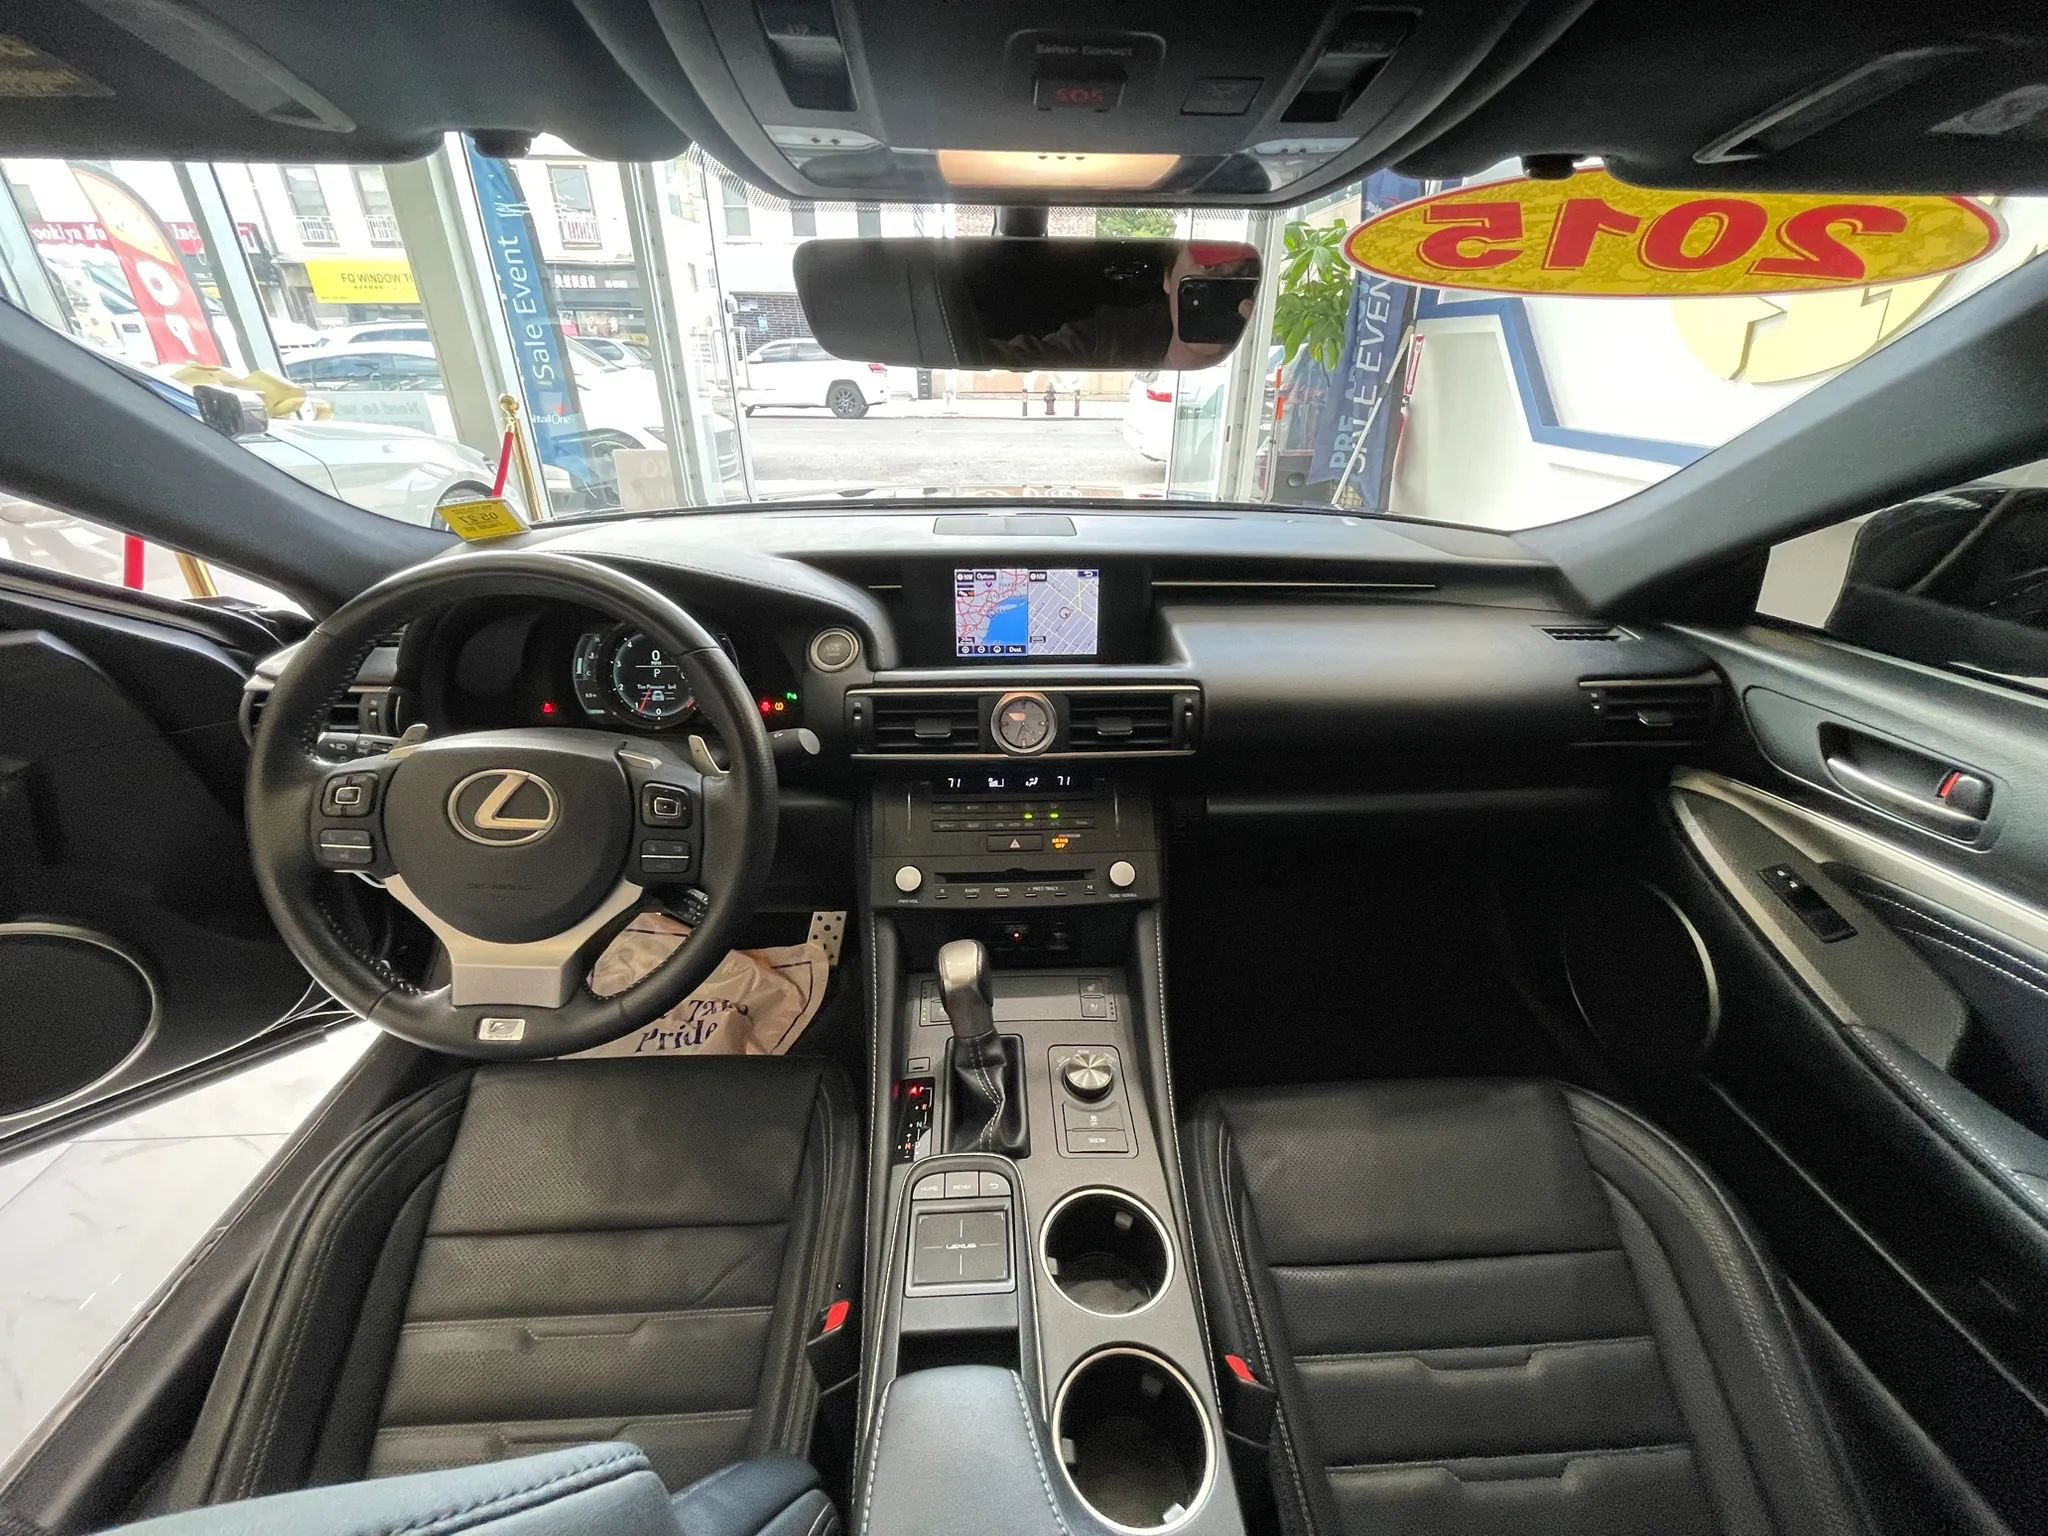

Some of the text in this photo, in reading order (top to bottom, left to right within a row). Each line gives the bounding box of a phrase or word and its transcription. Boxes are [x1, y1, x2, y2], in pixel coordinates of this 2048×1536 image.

[357, 273, 400, 283] WINDOW
[497, 235, 555, 380] Sale Event
[651, 650, 661, 661] 0
[654, 668, 661, 678] P
[948, 777, 961, 788] 71
[1057, 775, 1071, 786] 71
[634, 1020, 718, 1054] Pride
[945, 1242, 978, 1250] LEXUS
